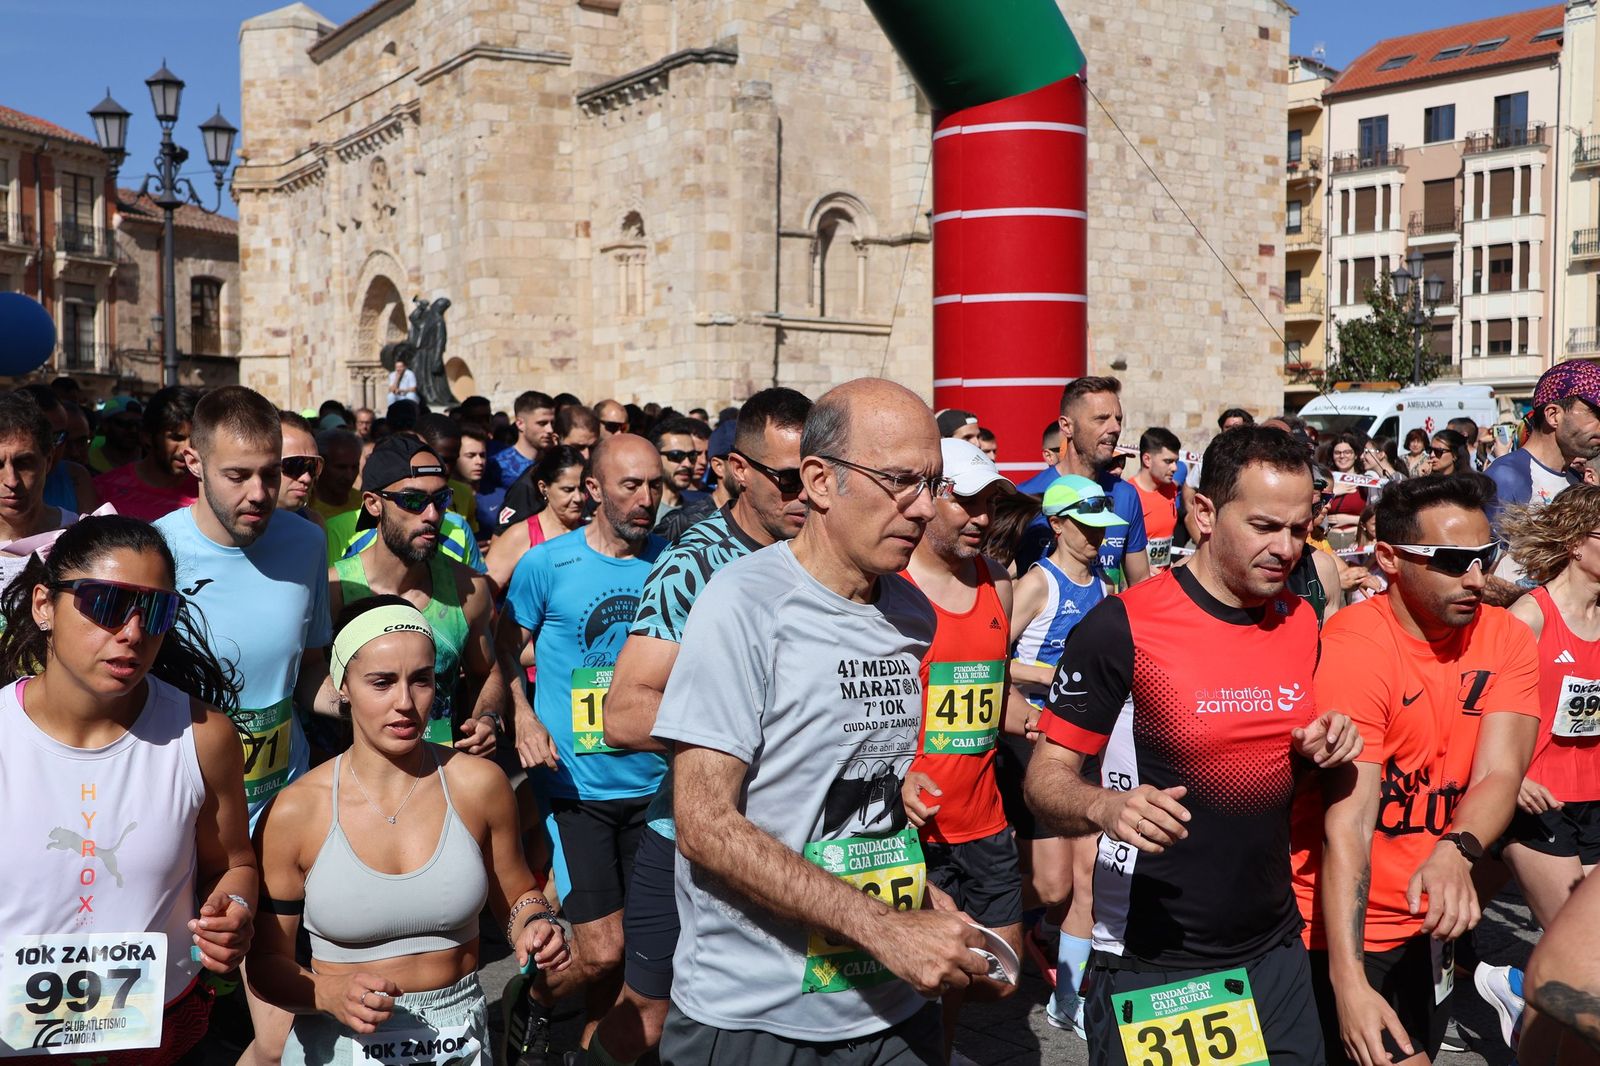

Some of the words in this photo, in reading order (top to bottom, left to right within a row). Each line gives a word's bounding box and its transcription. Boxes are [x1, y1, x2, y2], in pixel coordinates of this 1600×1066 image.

[1407, 400, 1443, 409] AMBULANCIA
[862, 660, 911, 678] MEDIA
[880, 699, 906, 716] 10K
[935, 688, 994, 726] 415
[1196, 699, 1274, 713] zamora
[843, 721, 878, 733] CIUDAD
[880, 721, 889, 730] DE
[868, 744, 879, 753] de
[879, 742, 895, 752] abril
[952, 738, 976, 748] CAJA
[253, 777, 283, 797] RURAL
[78, 783, 97, 914] HYROX
[849, 854, 873, 870] CAJA
[873, 850, 909, 867] RURAL
[15, 945, 56, 966] 10K
[61, 943, 157, 964] ZAMORA
[25, 968, 142, 1015] 997
[1152, 998, 1178, 1011] CAJA
[1179, 990, 1214, 1006] RURAL
[63, 1032, 97, 1046] ZAMORA
[1137, 1010, 1237, 1066] 315
[362, 1043, 396, 1060] 10K
